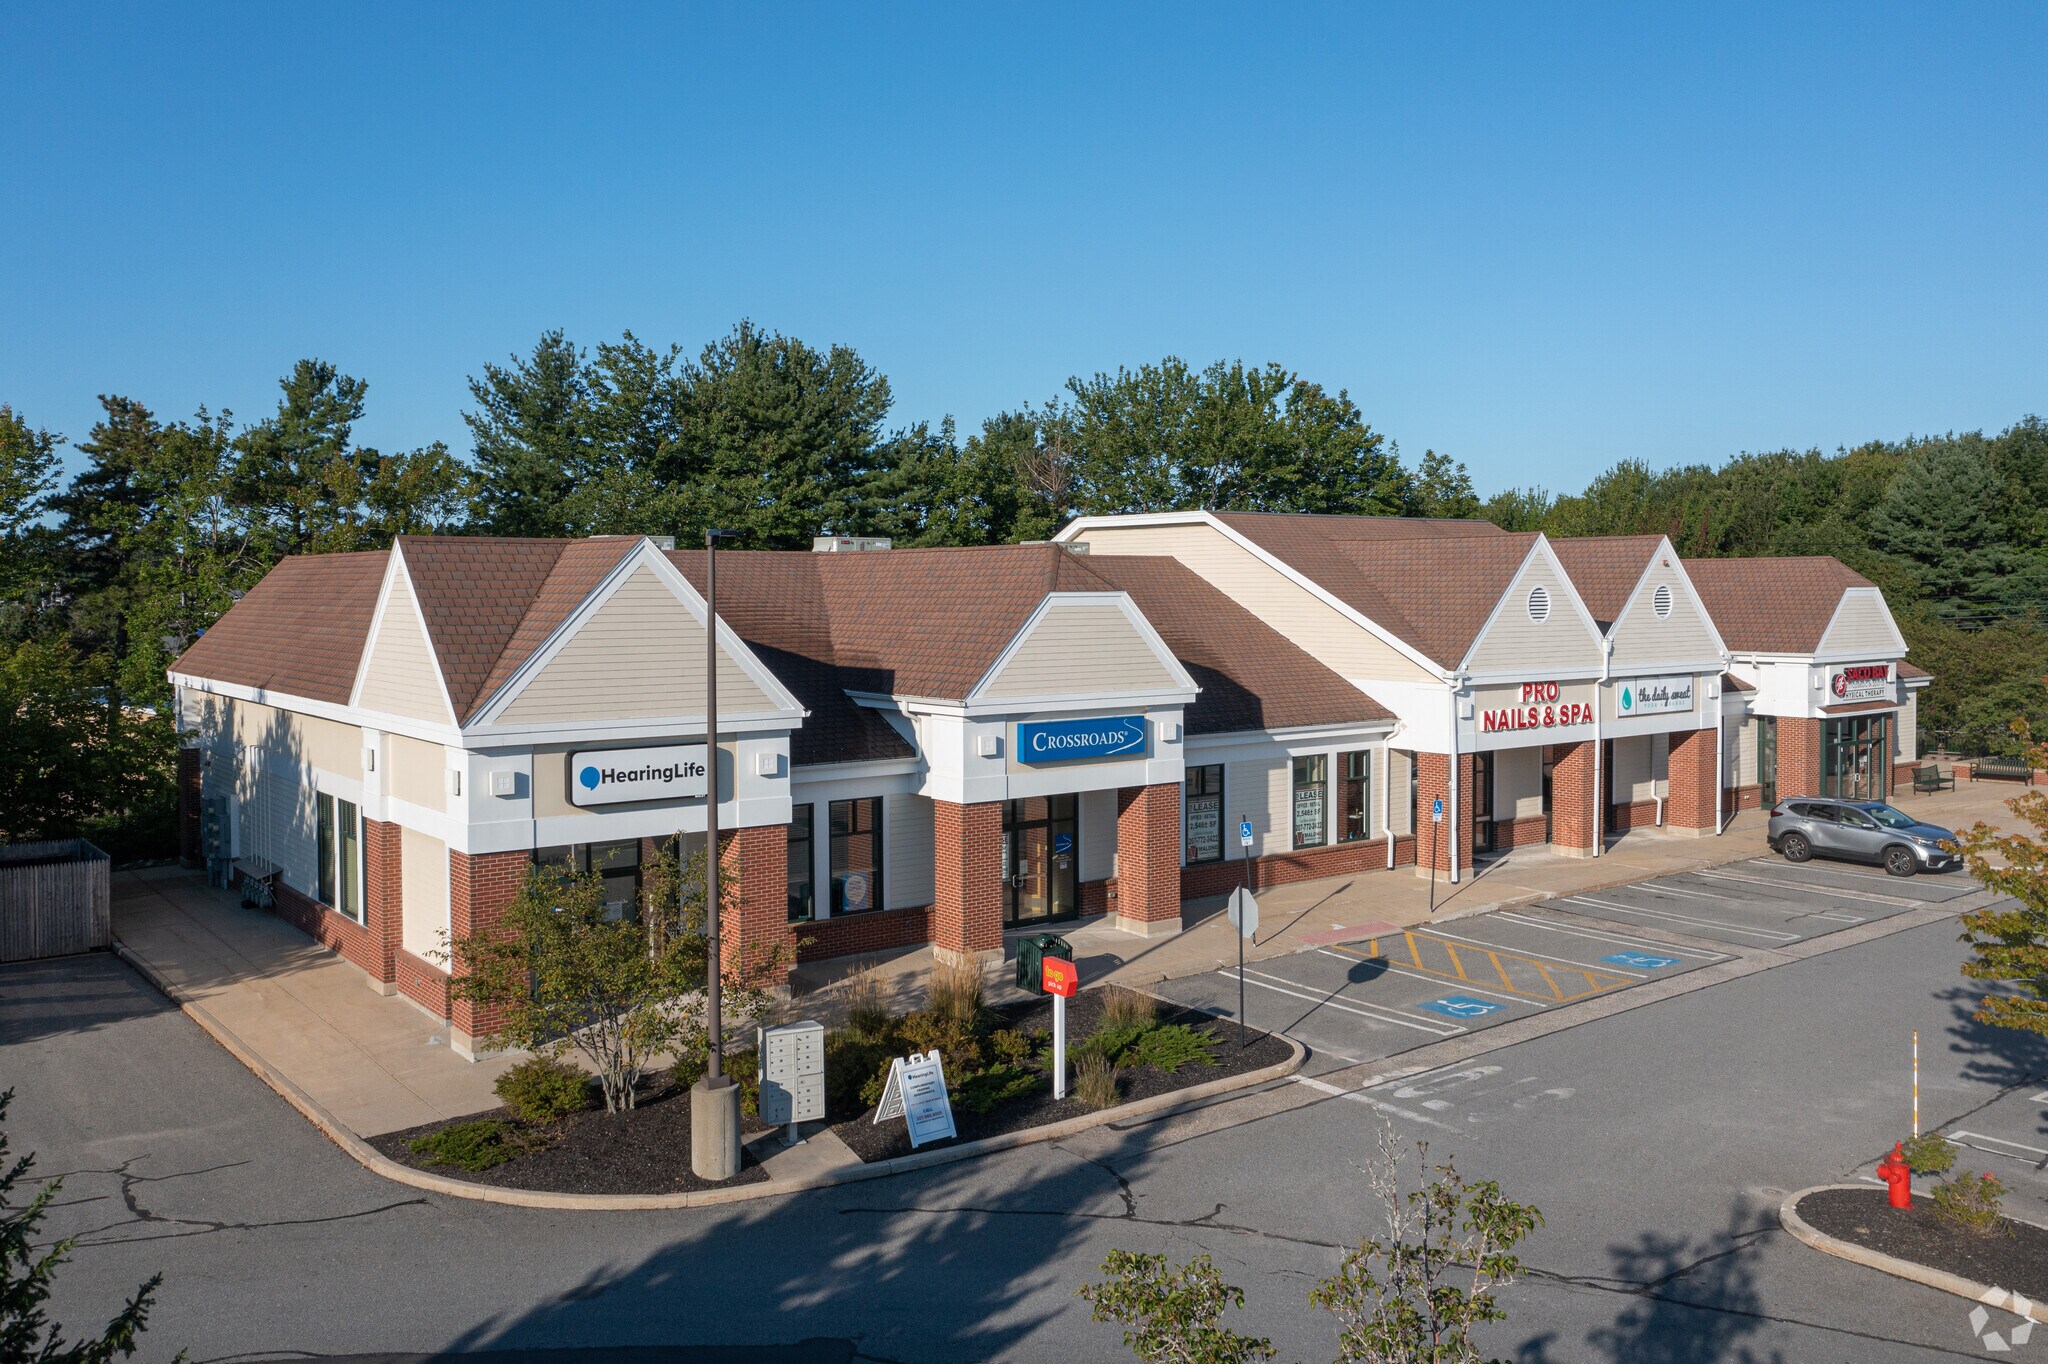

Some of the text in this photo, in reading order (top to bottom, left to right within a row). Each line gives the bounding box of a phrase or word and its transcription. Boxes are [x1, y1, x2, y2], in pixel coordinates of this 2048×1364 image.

[1847, 667, 1871, 681] SACO
[1520, 681, 1560, 703] PRO
[1638, 685, 1691, 707] the daily sweat
[1481, 703, 1593, 731] NAILS & SPA
[601, 762, 705, 784] HearingLife
[1300, 791, 1322, 800] LEASE
[1193, 802, 1218, 810] LEASE
[1045, 965, 1064, 982] to go
[913, 1071, 933, 1079] HearingLife
